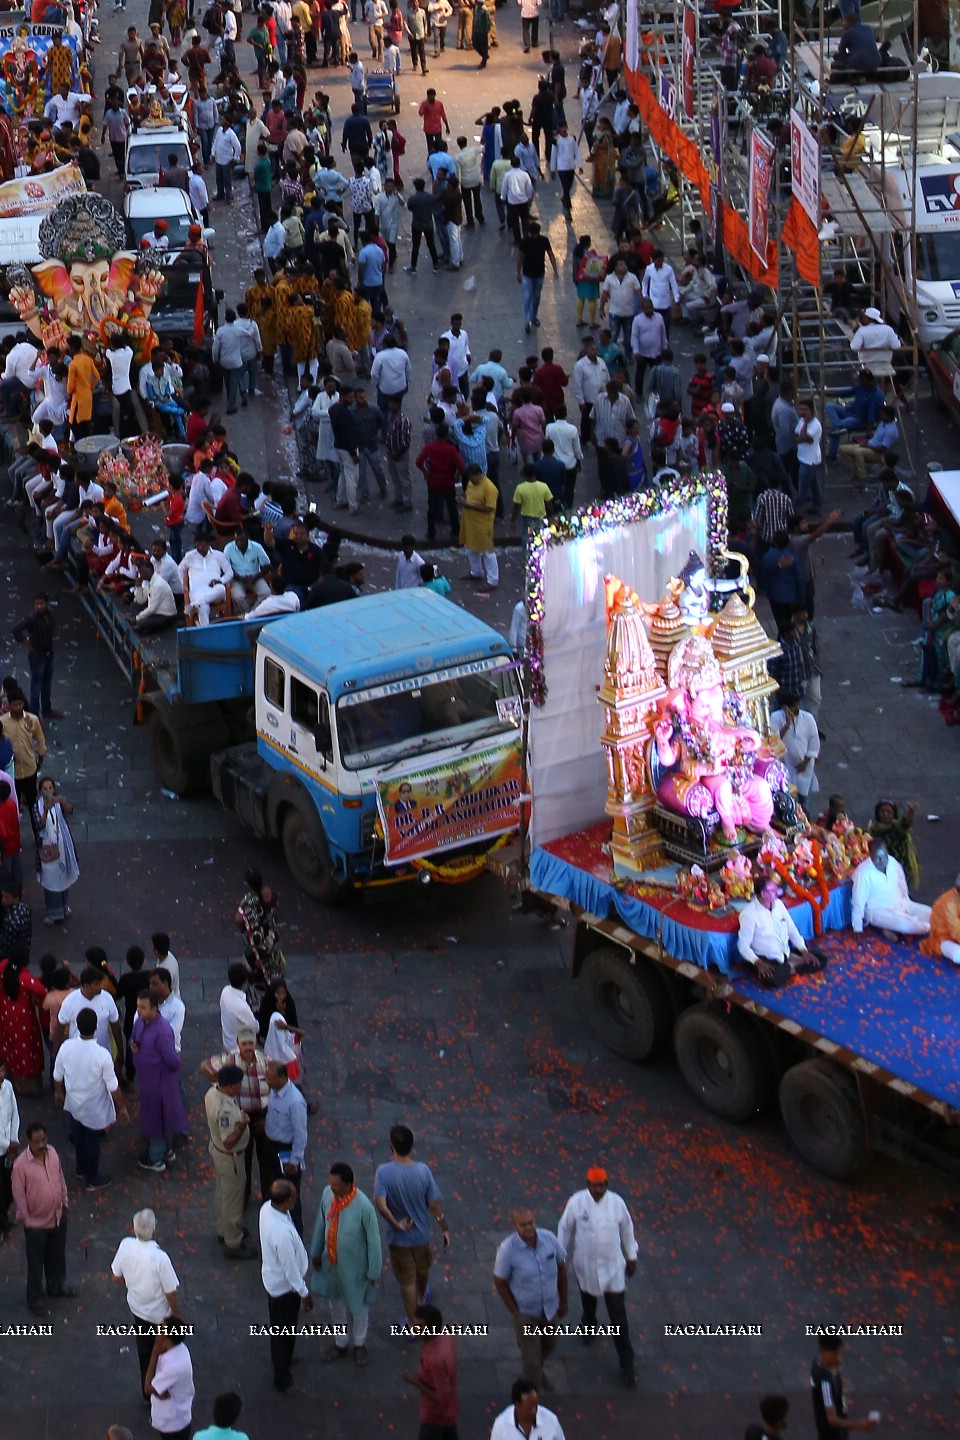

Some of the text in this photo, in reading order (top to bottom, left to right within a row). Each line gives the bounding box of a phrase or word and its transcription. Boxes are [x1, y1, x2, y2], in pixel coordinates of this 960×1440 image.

[345, 660, 498, 705] ALL INDIA PERMIT
[365, 650, 484, 686] GOODS CARRIER
[395, 812, 418, 828] DR.
[453, 779, 519, 809] AMBEDKAR
